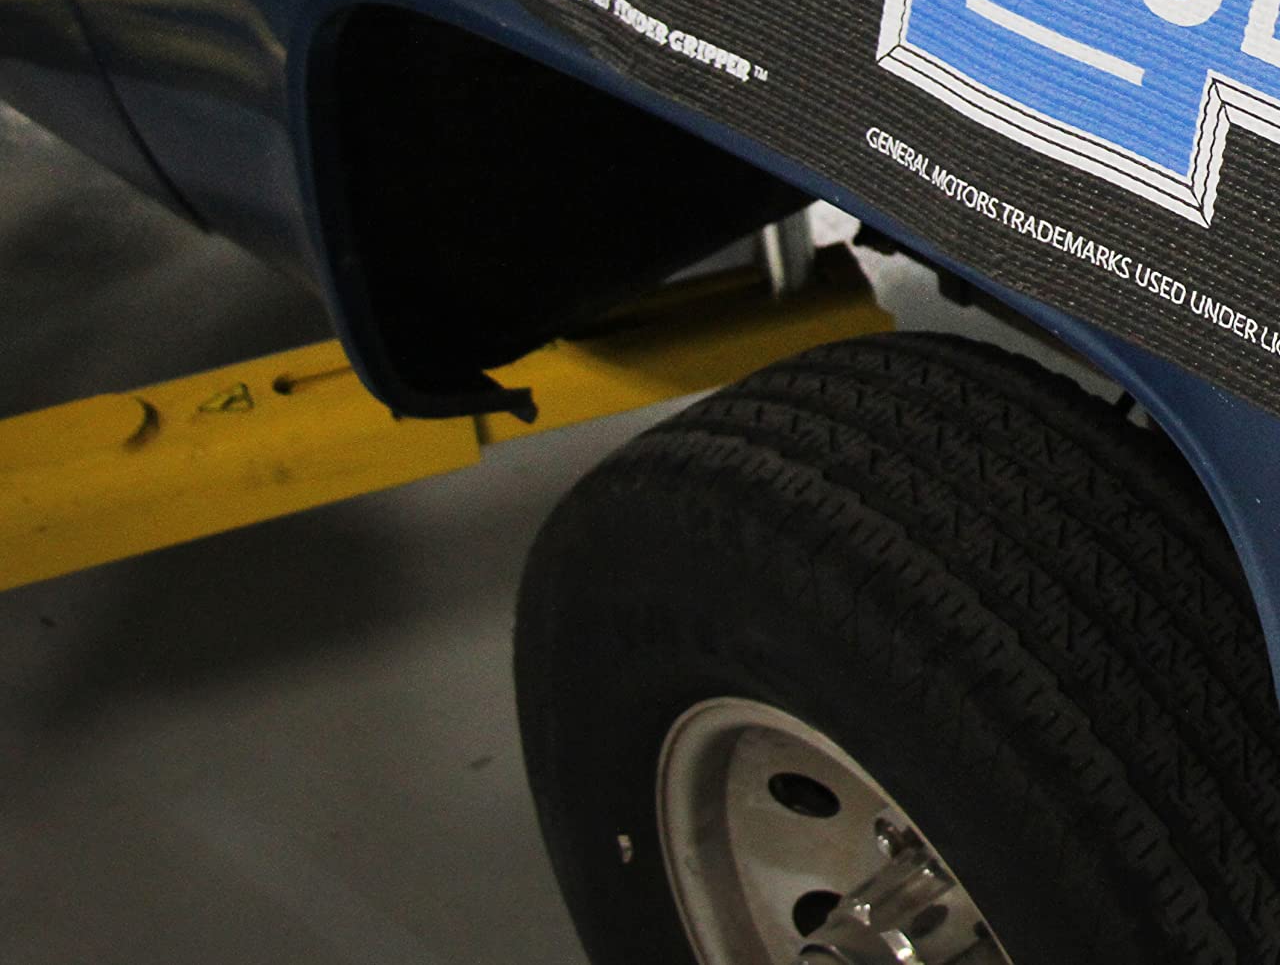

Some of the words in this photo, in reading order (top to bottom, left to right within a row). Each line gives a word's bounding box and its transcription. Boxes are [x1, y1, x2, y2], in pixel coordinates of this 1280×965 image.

[668, 30, 751, 82] GRIPPER
[865, 127, 931, 181] GENERAL
[931, 165, 999, 219] MOTORS
[1001, 202, 1133, 279] TRADEMARKS
[1135, 263, 1187, 305] USED
[1190, 290, 1262, 344] UNDER
